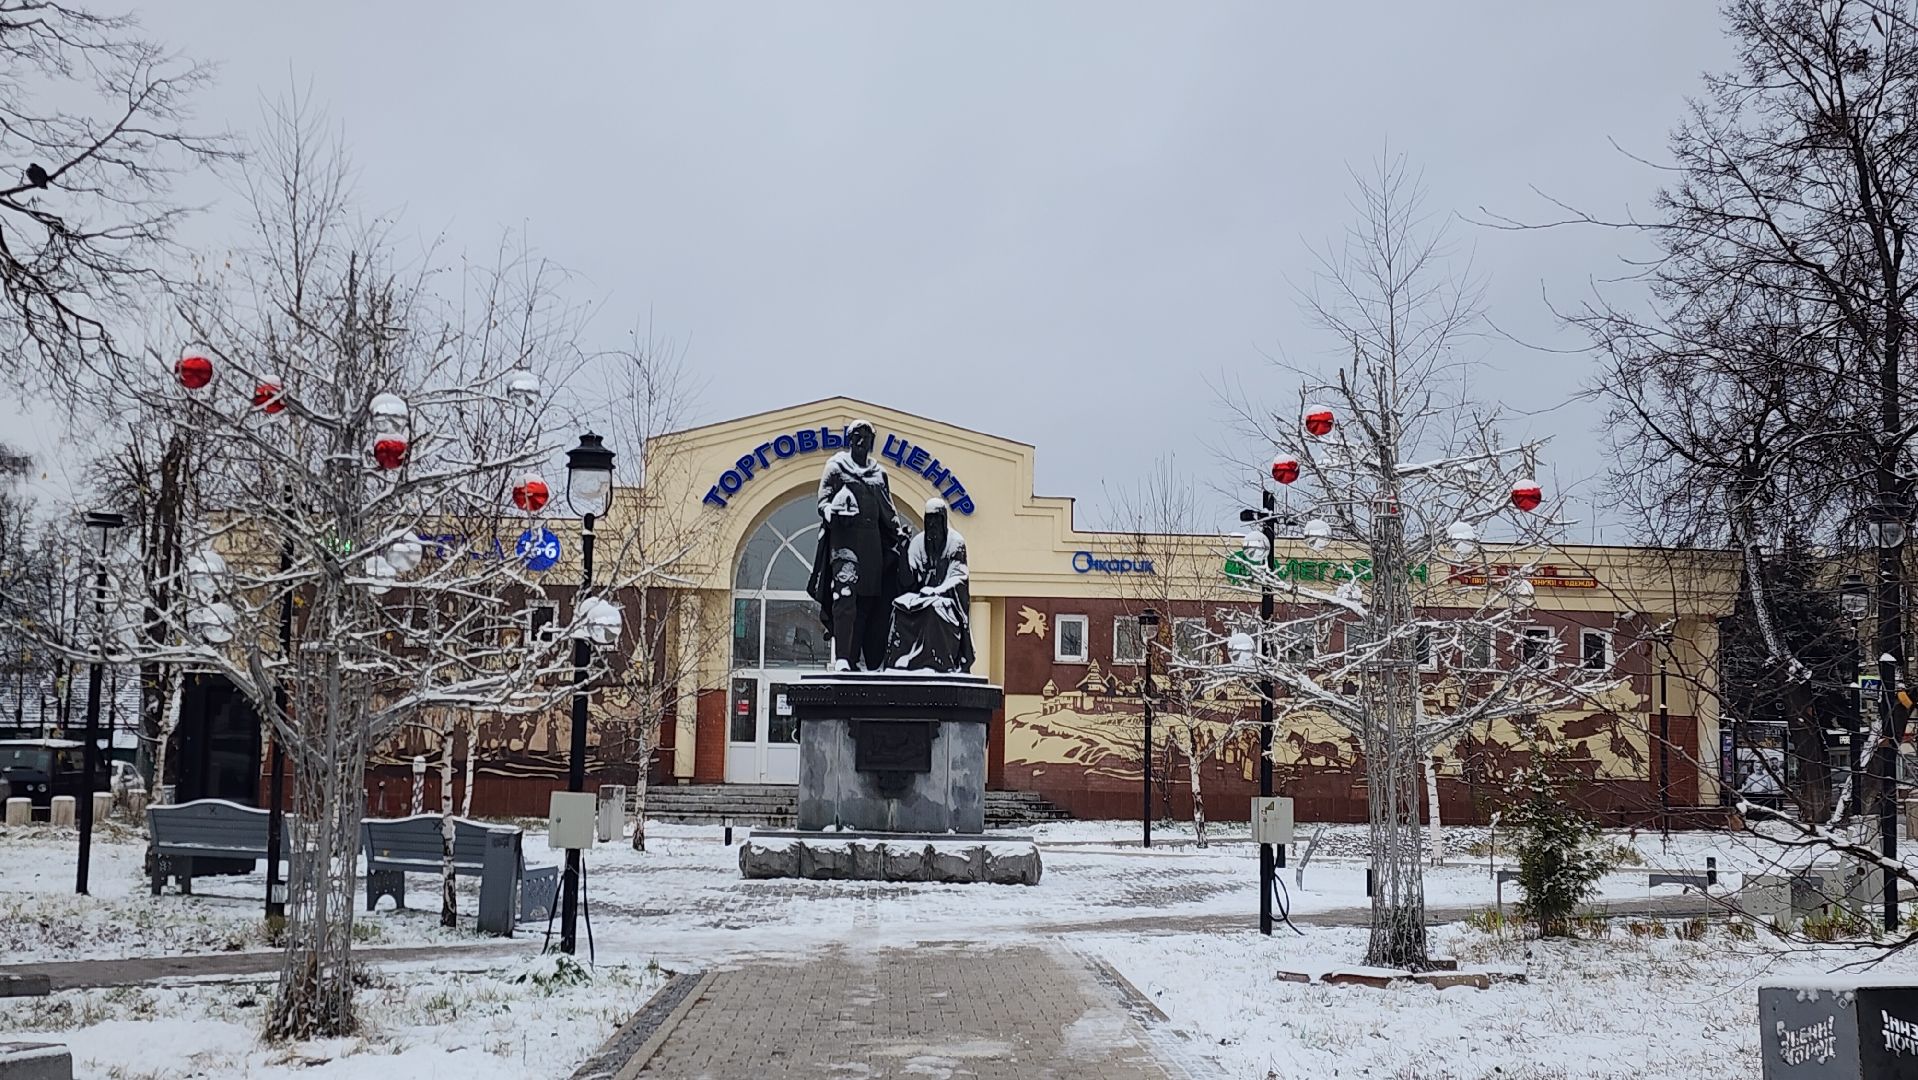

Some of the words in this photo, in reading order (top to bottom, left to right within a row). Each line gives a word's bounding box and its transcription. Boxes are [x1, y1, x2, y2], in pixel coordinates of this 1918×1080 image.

[702, 426, 874, 508] ТОРГОВЫ
[881, 433, 976, 516] ЦЕНТР
[1272, 559, 1427, 584] МЕГАФН
[1564, 580, 1595, 588] ОДЕЖДА
